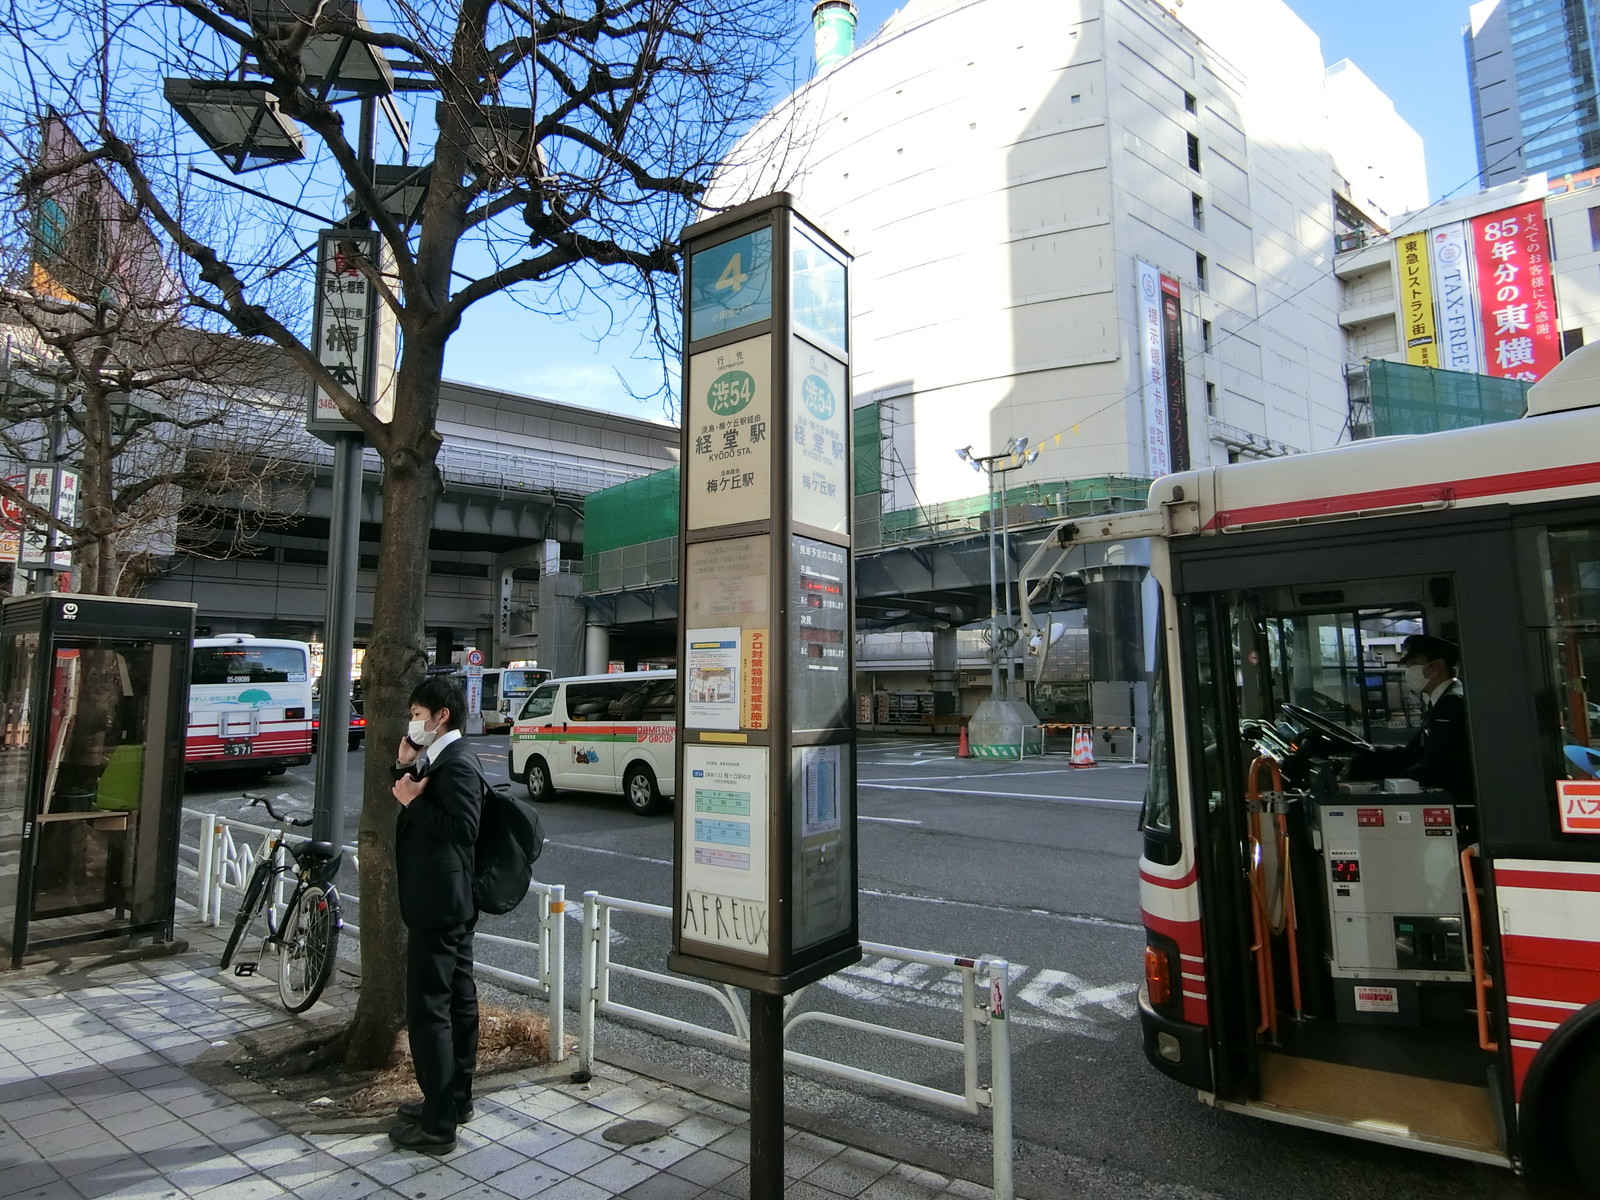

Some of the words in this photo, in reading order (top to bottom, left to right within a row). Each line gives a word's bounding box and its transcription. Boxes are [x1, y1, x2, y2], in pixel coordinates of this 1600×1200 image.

[715, 252, 748, 292] 4
[1405, 241, 1426, 335] 東急レストラン街
[1523, 213, 1551, 340] すべてのお客様に大感謝。
[1444, 269, 1470, 367] TAX-FREE
[712, 377, 751, 412] 渋54
[805, 378, 832, 417] 渋54
[695, 422, 766, 455] 経堂駅
[736, 447, 753, 458] STA.
[794, 423, 843, 460] 経堂駅
[648, 725, 677, 735] MITSUW
[649, 734, 674, 743] GROUP
